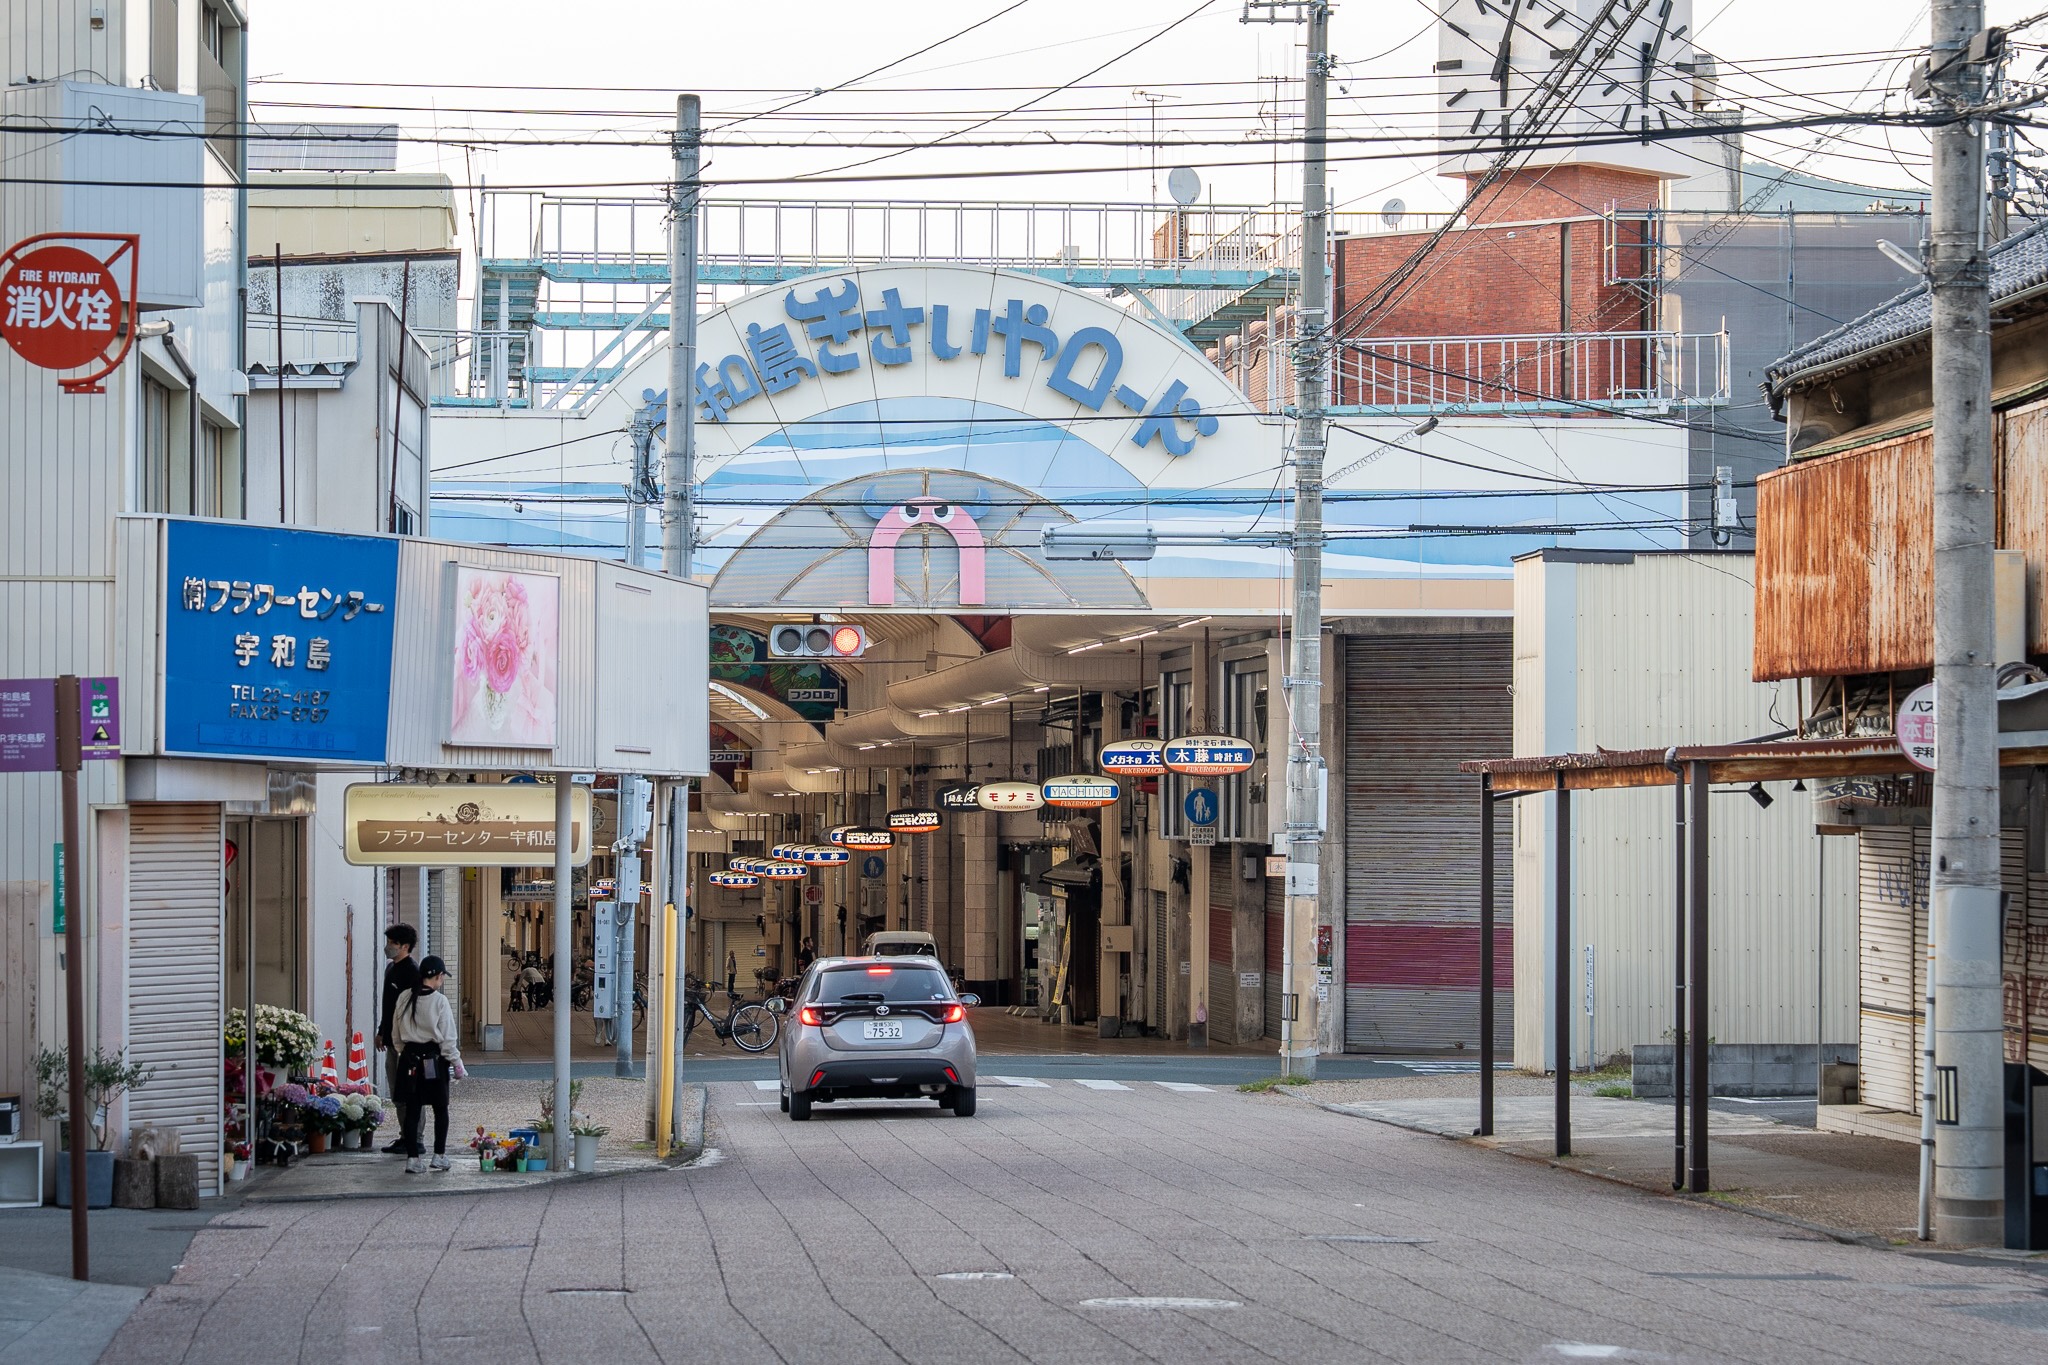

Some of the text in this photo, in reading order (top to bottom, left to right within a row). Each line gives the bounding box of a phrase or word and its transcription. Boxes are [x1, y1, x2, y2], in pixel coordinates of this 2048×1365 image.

[19, 269, 101, 286] FIRE HYDRANT
[5, 285, 113, 331] 消火栓
[234, 632, 331, 671] 宇和島
[231, 684, 258, 701] TEL
[790, 690, 836, 700] フクロ町
[230, 703, 258, 719] FAX
[1108, 755, 1142, 765] メガネの
[1175, 748, 1243, 763] 木藤 時計店
[989, 792, 1035, 802] モナミ
[376, 829, 556, 847] フラワーセンター宇和島
[872, 1028, 900, 1037] 75-32
